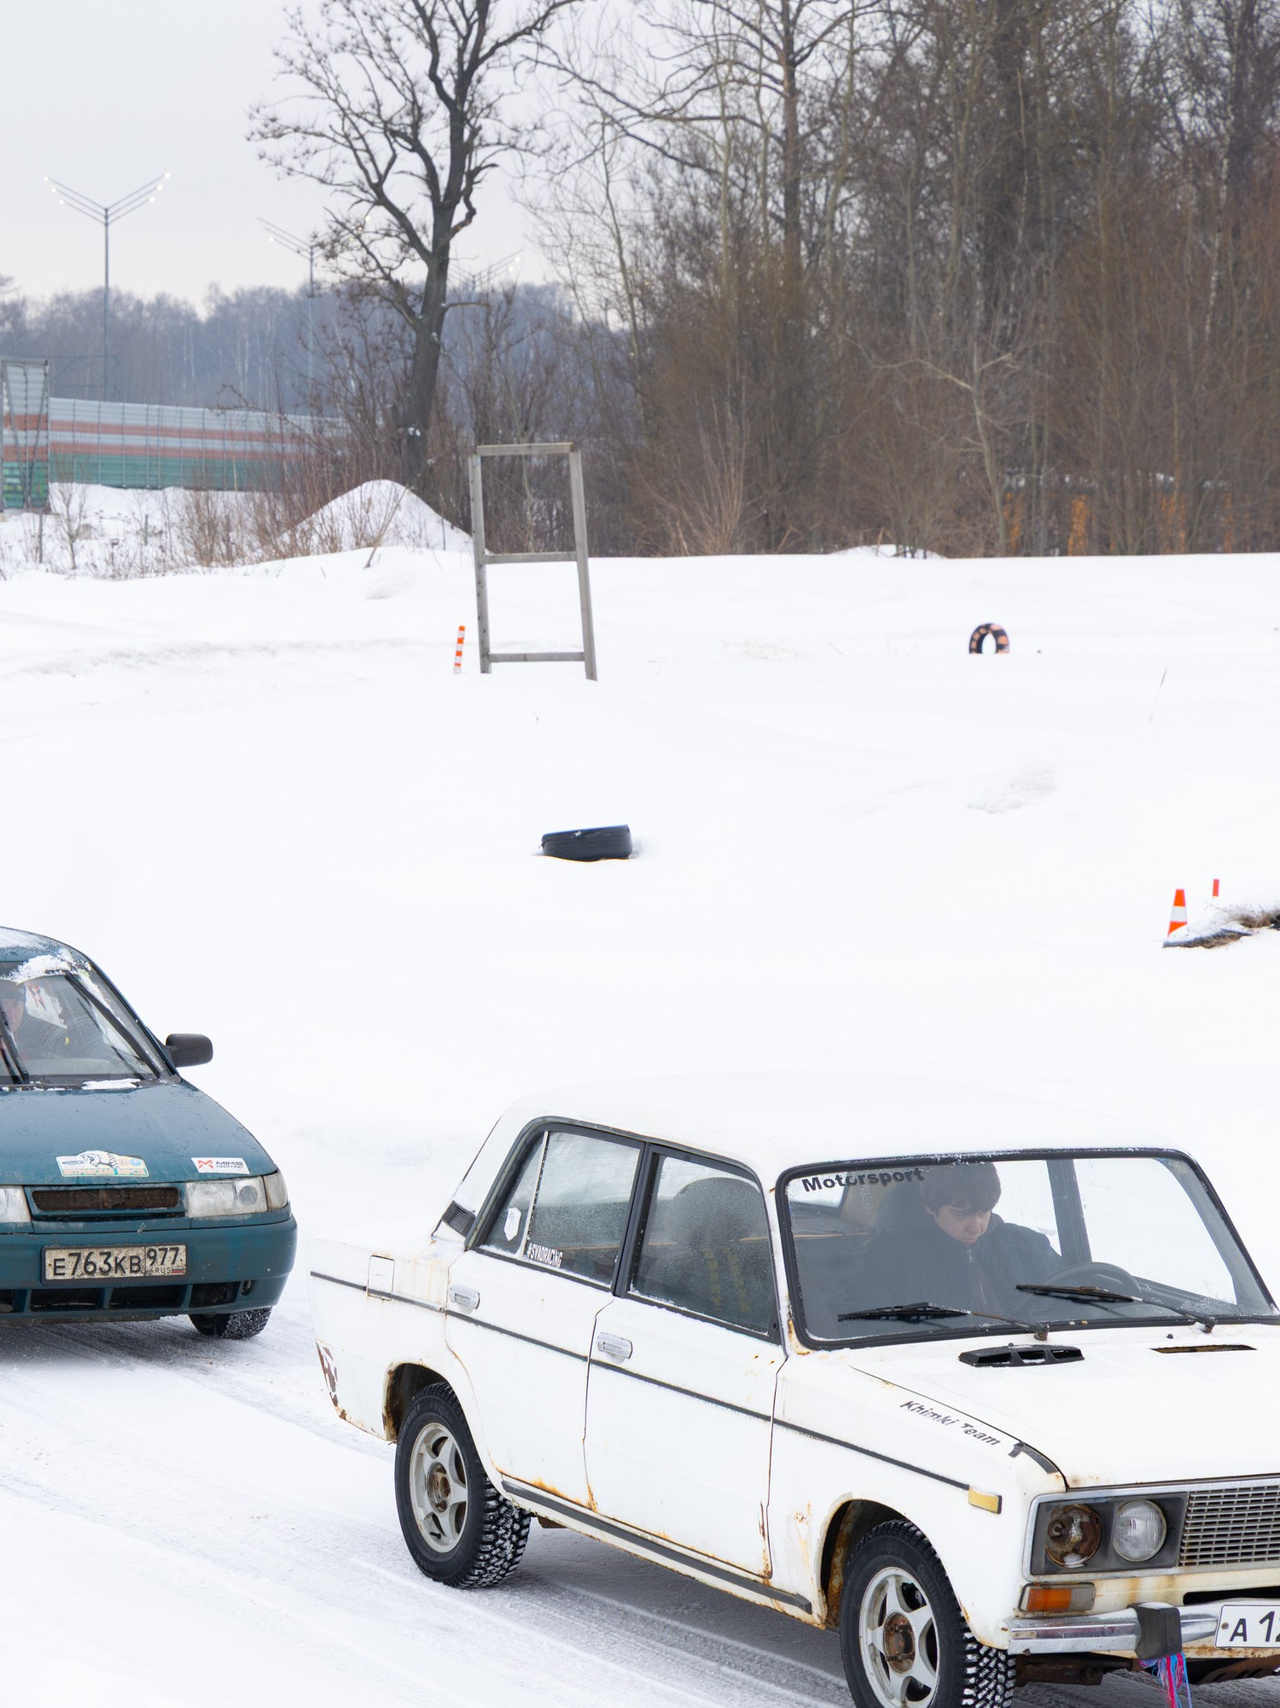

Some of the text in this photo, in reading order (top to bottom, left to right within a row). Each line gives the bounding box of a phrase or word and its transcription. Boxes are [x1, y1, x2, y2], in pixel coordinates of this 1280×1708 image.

[801, 1167, 925, 1193] Motorsport
[146, 1247, 180, 1267] 977
[154, 1266, 172, 1274] RUS
[900, 1400, 1001, 1446] Khimki Team
